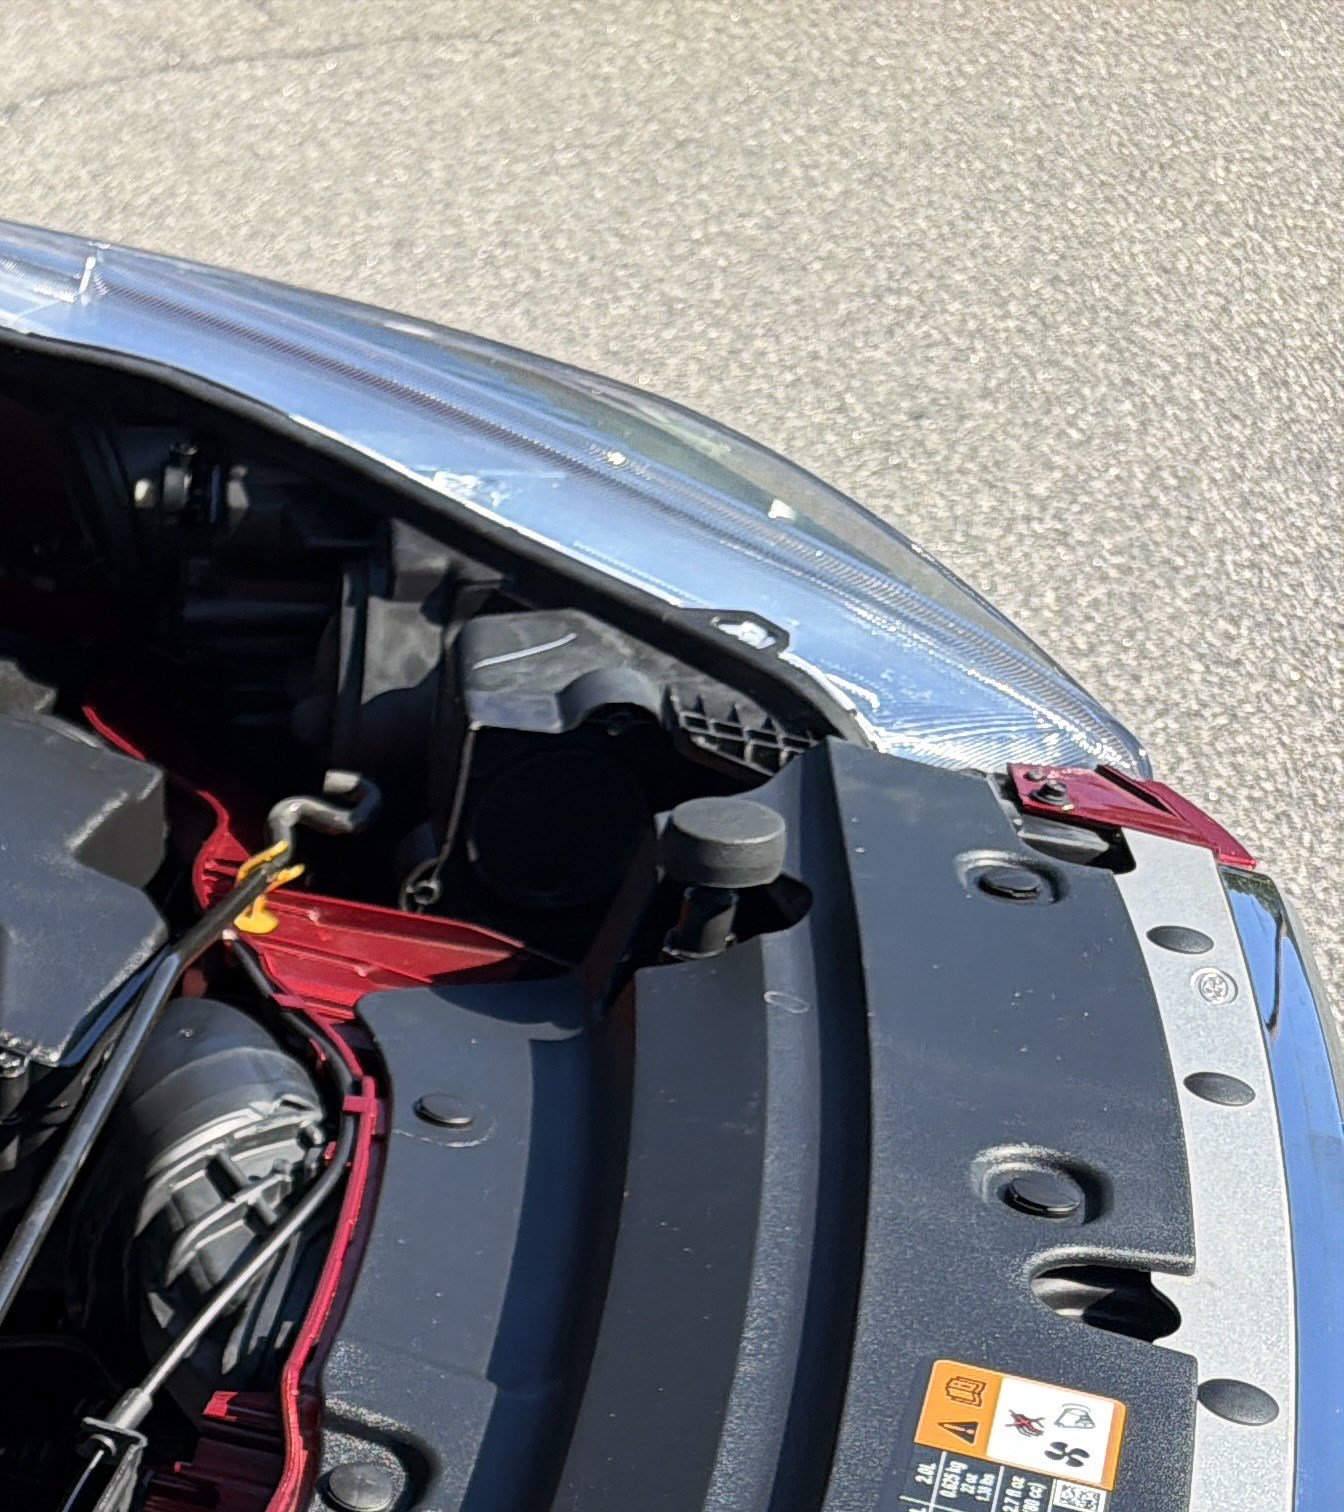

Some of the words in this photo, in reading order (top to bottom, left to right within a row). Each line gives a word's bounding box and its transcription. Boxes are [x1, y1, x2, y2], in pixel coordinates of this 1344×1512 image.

[915, 1463, 936, 1484] 2.0L
[1011, 1476, 1026, 1489] oz
[1027, 1482, 1047, 1498] cc)
